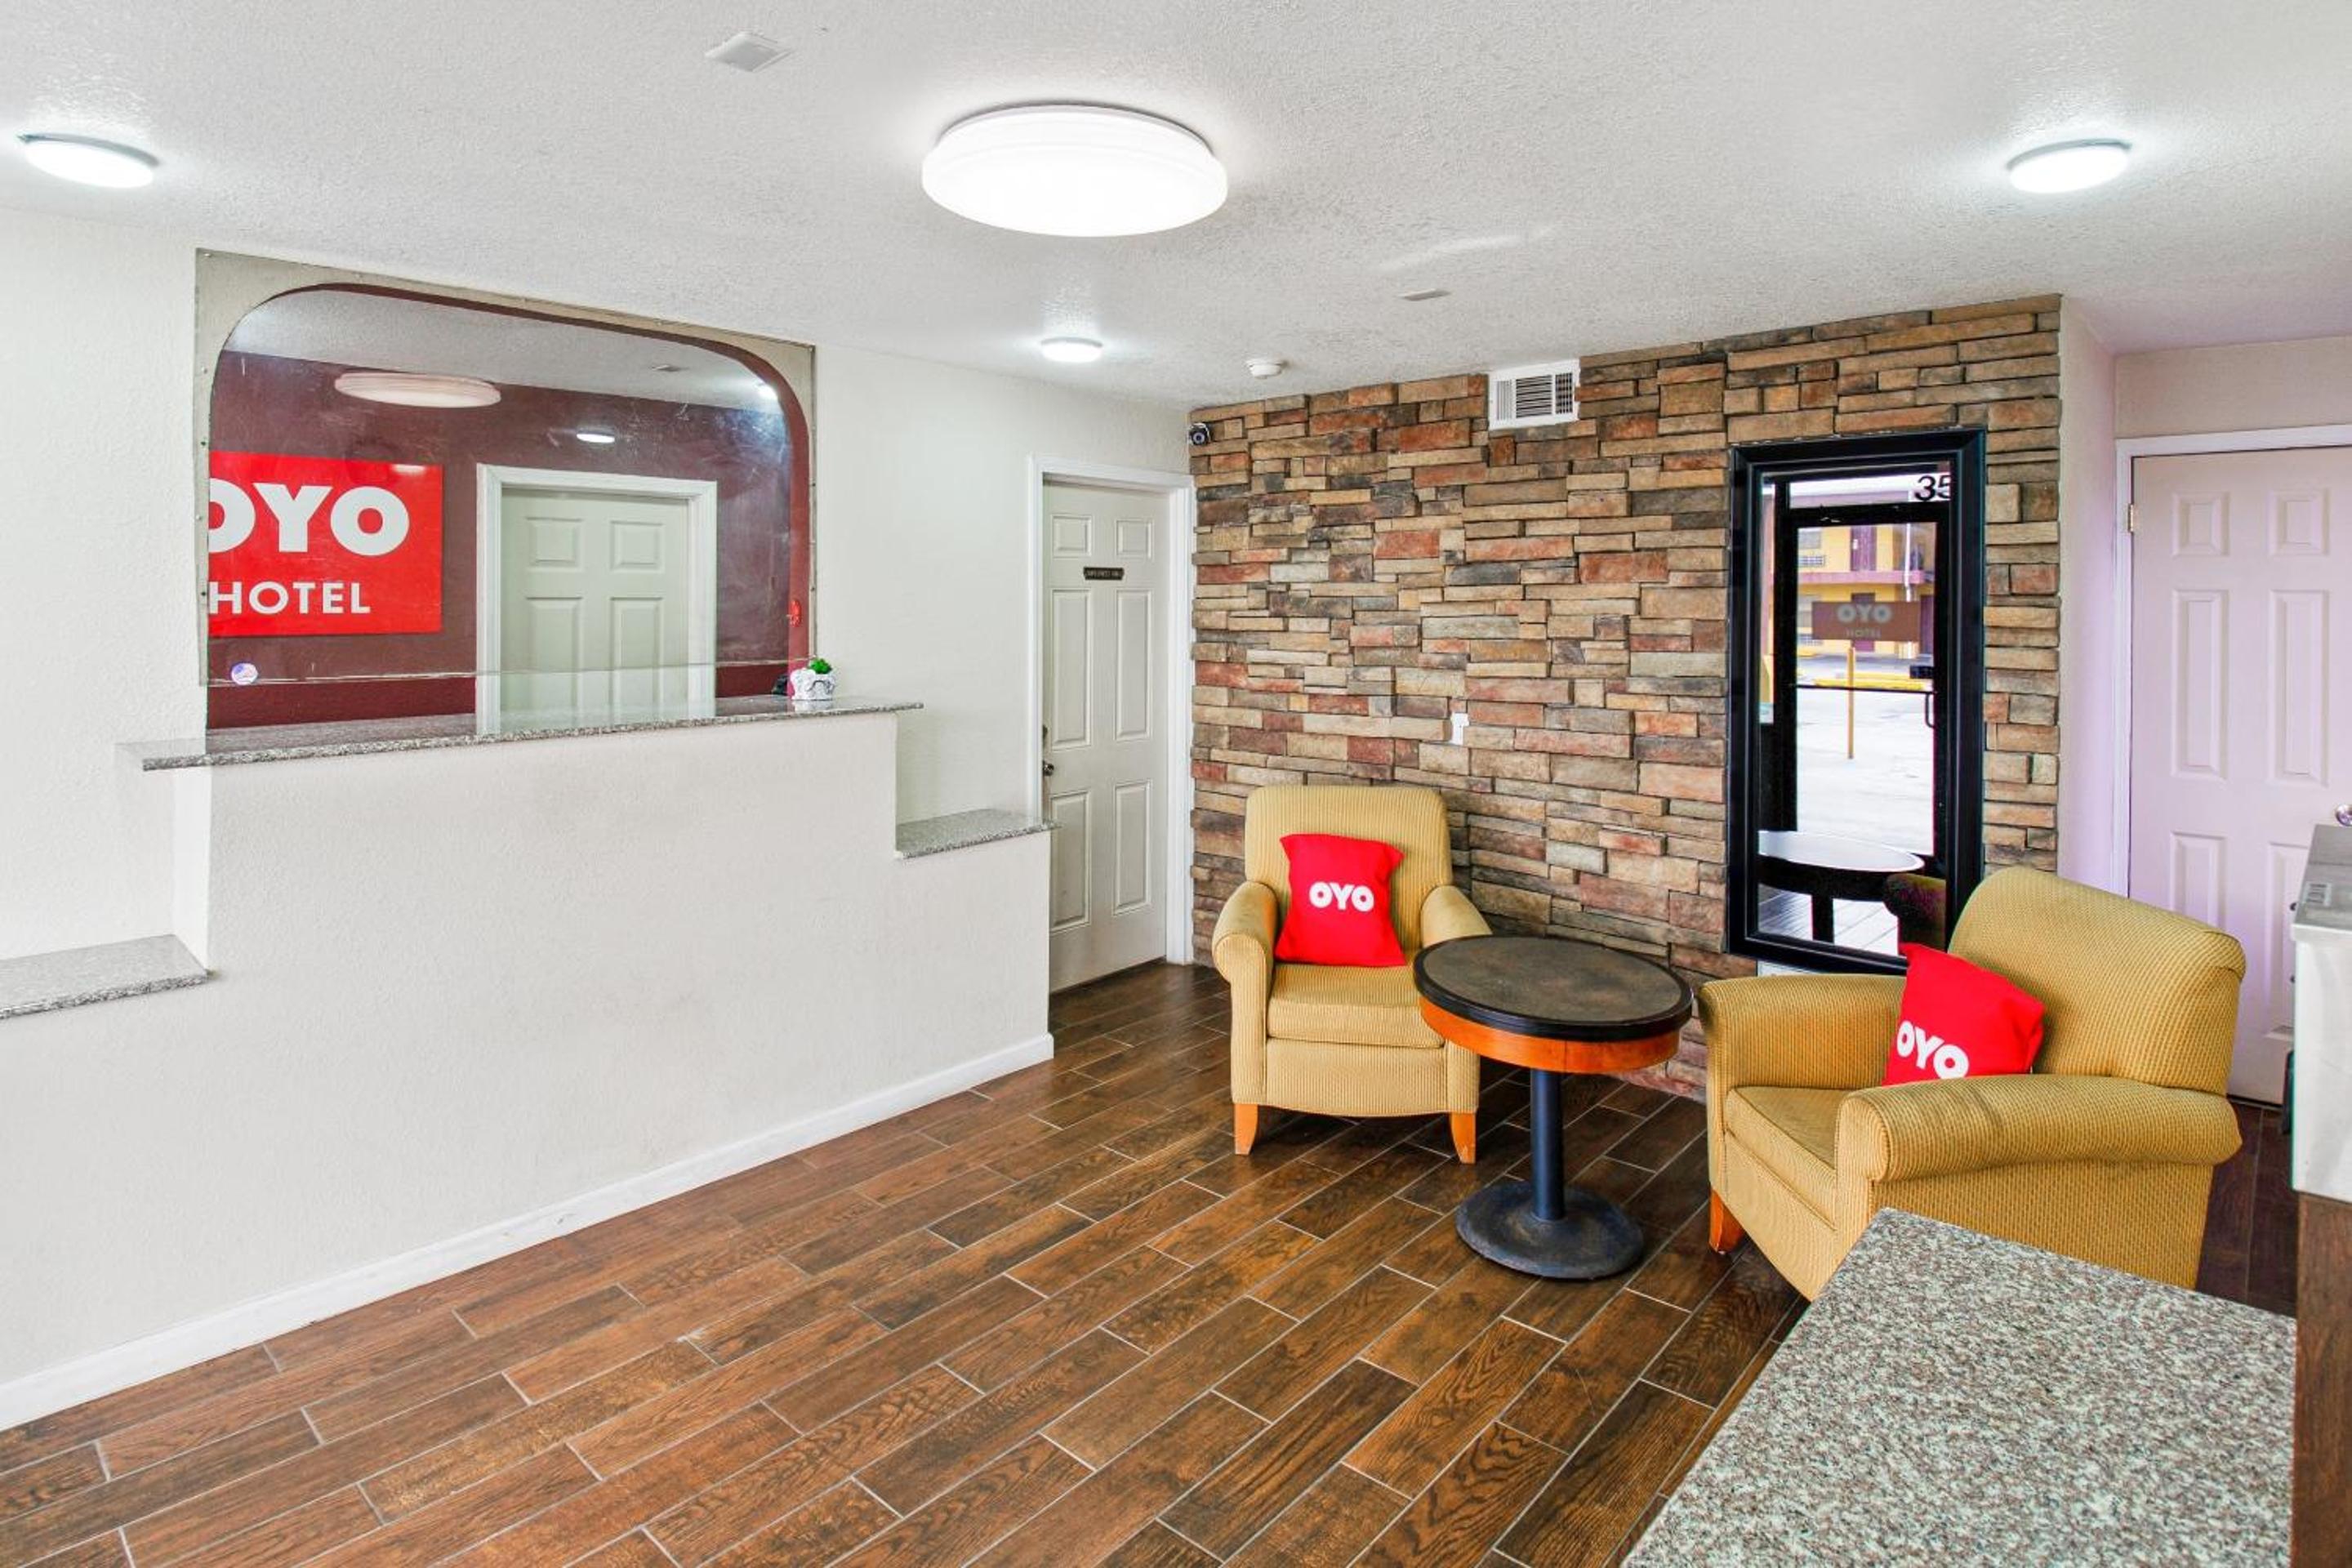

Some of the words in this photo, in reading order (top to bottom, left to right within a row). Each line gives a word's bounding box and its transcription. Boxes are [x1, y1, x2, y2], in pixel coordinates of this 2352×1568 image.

[209, 581, 371, 614] HOTEL
[1837, 604, 1893, 623] OYO
[1308, 880, 1375, 913] OYO
[1895, 1020, 1970, 1080] OYO
